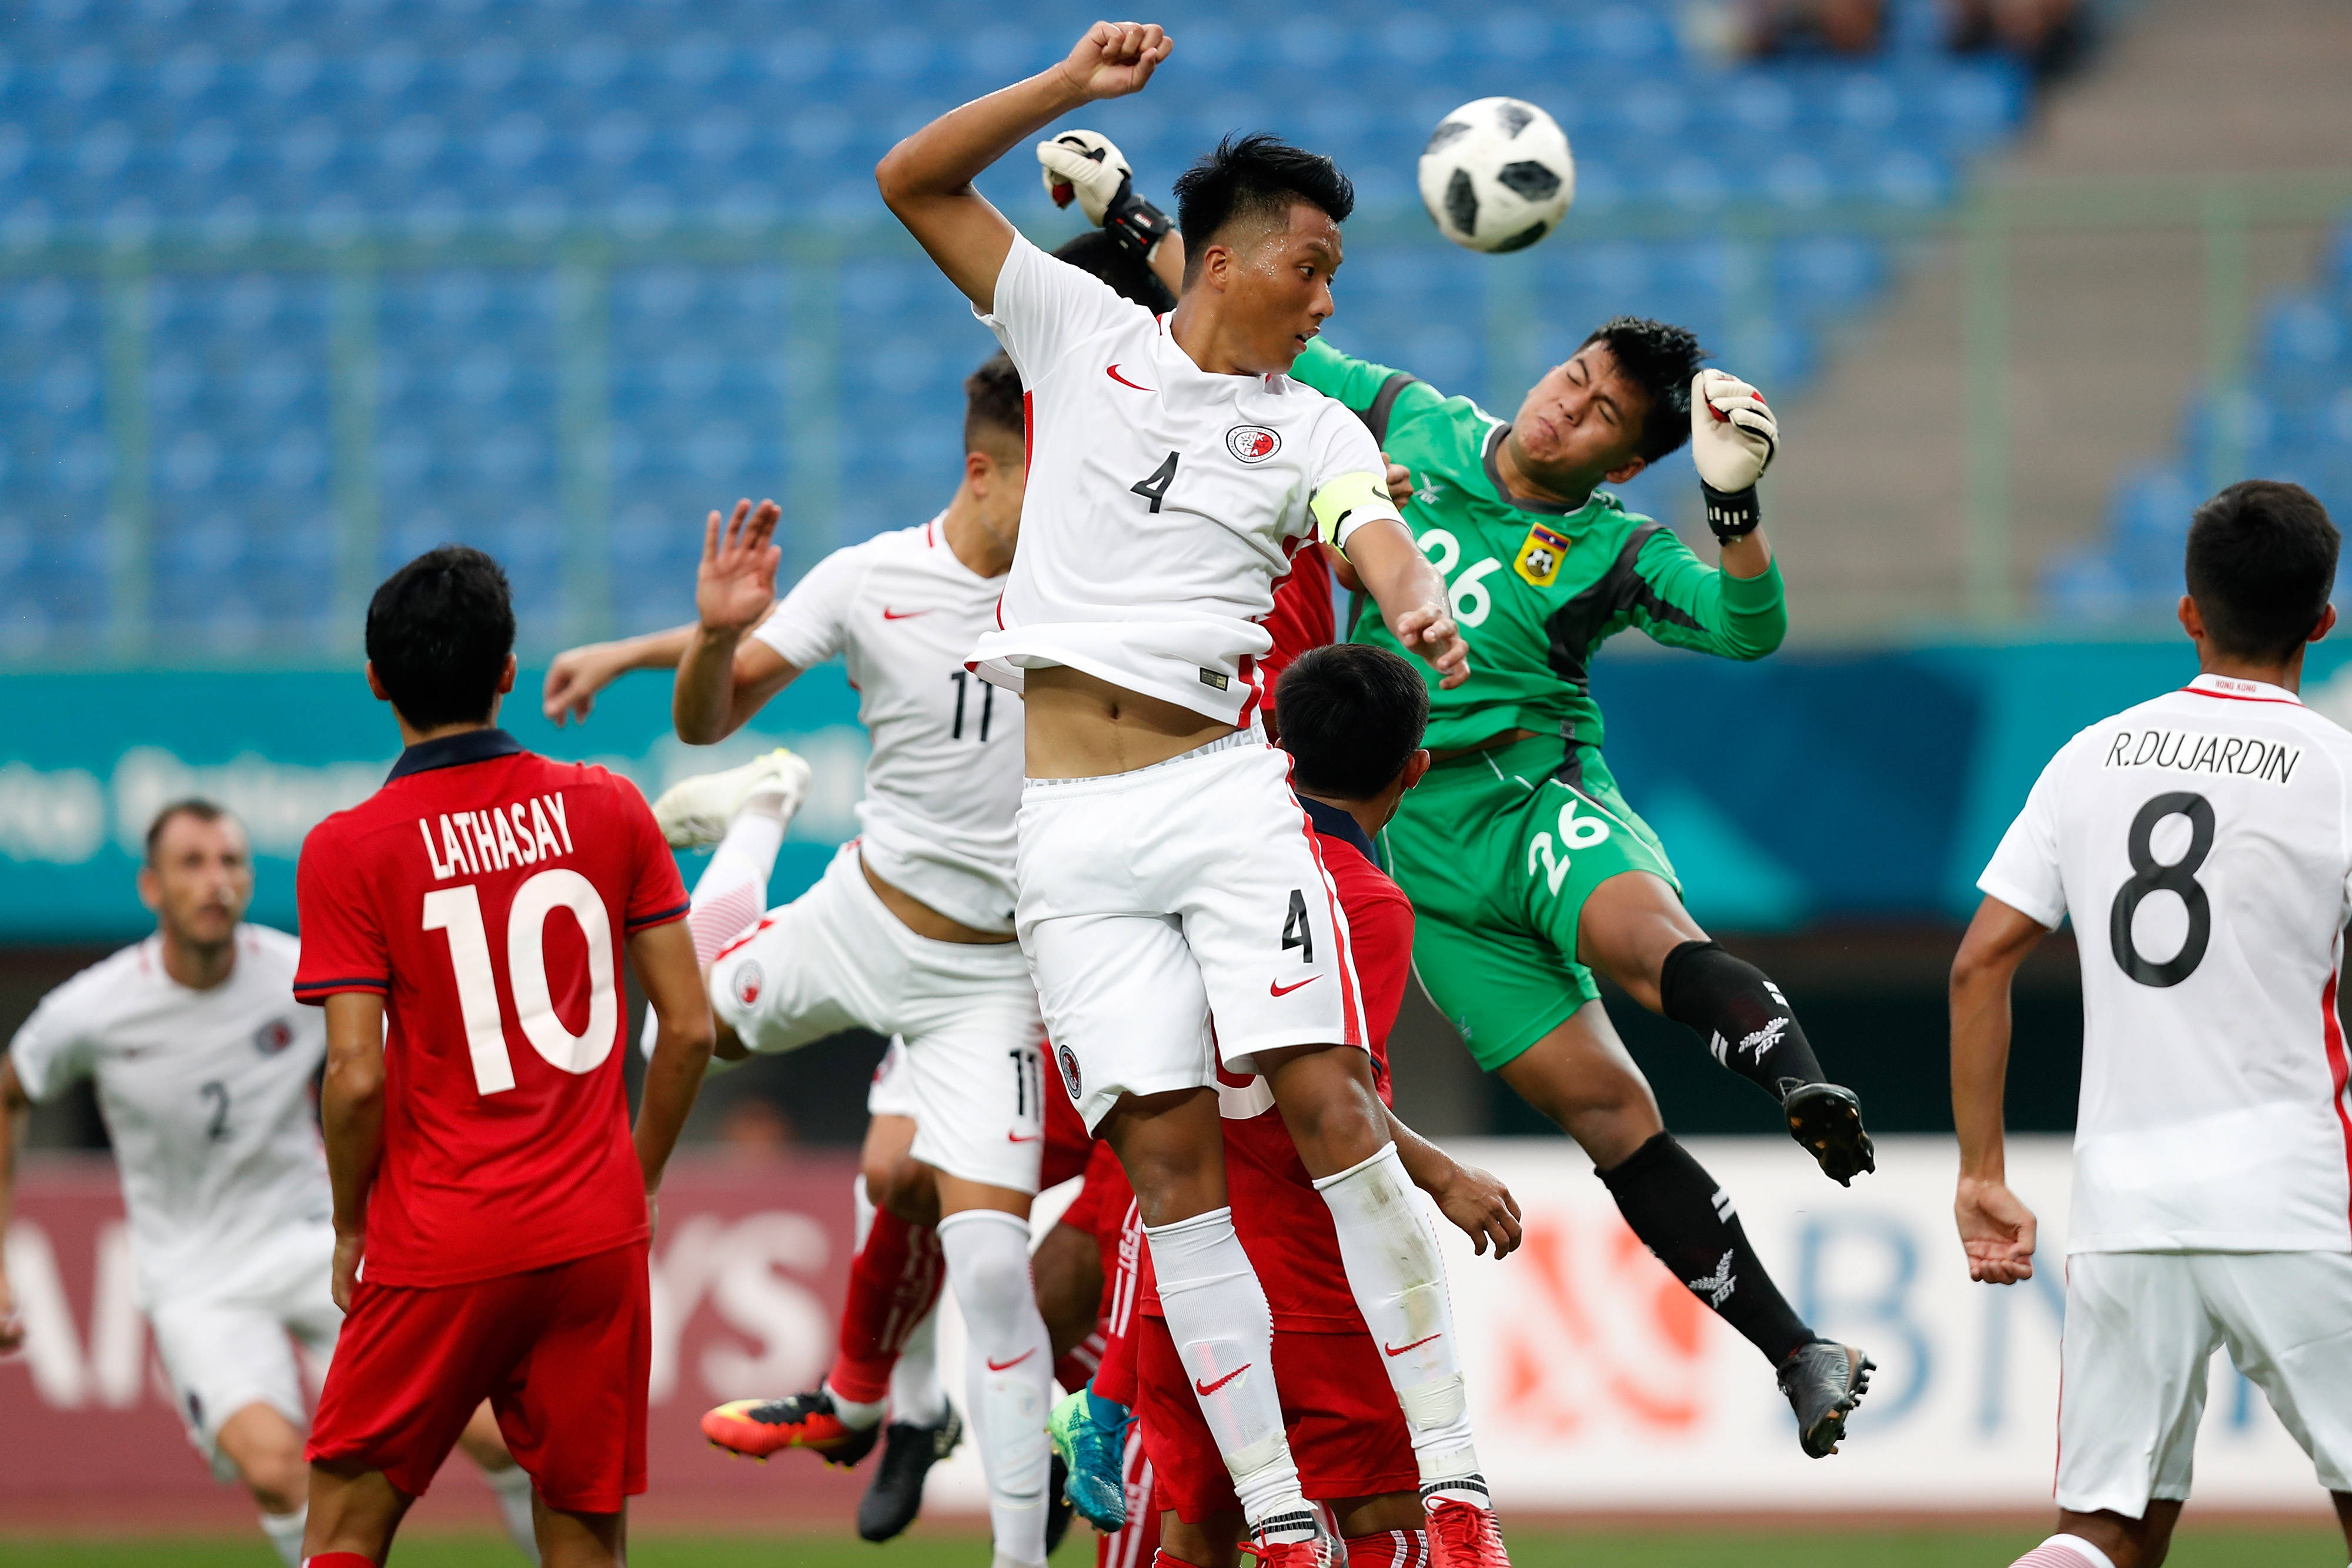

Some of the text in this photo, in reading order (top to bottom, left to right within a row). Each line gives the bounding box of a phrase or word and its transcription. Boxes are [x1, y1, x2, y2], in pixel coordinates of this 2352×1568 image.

[1130, 452, 1180, 513] 4
[1417, 529, 1502, 628] 26
[951, 671, 992, 742] 11
[2216, 678, 2257, 692] HONG KONG
[2106, 731, 2300, 784] R.DUJARDIN
[419, 792, 573, 880] LATHASAY
[1528, 799, 1610, 896] 26
[2110, 791, 2216, 988] 8
[1282, 889, 1313, 963] 4
[423, 869, 617, 1095] 10
[1755, 1032, 1785, 1066] FBT
[200, 1081, 231, 1141] 2
[1010, 1048, 1040, 1123] 11
[1118, 1227, 1141, 1275] FBT
[1710, 1274, 1737, 1309] FBT
